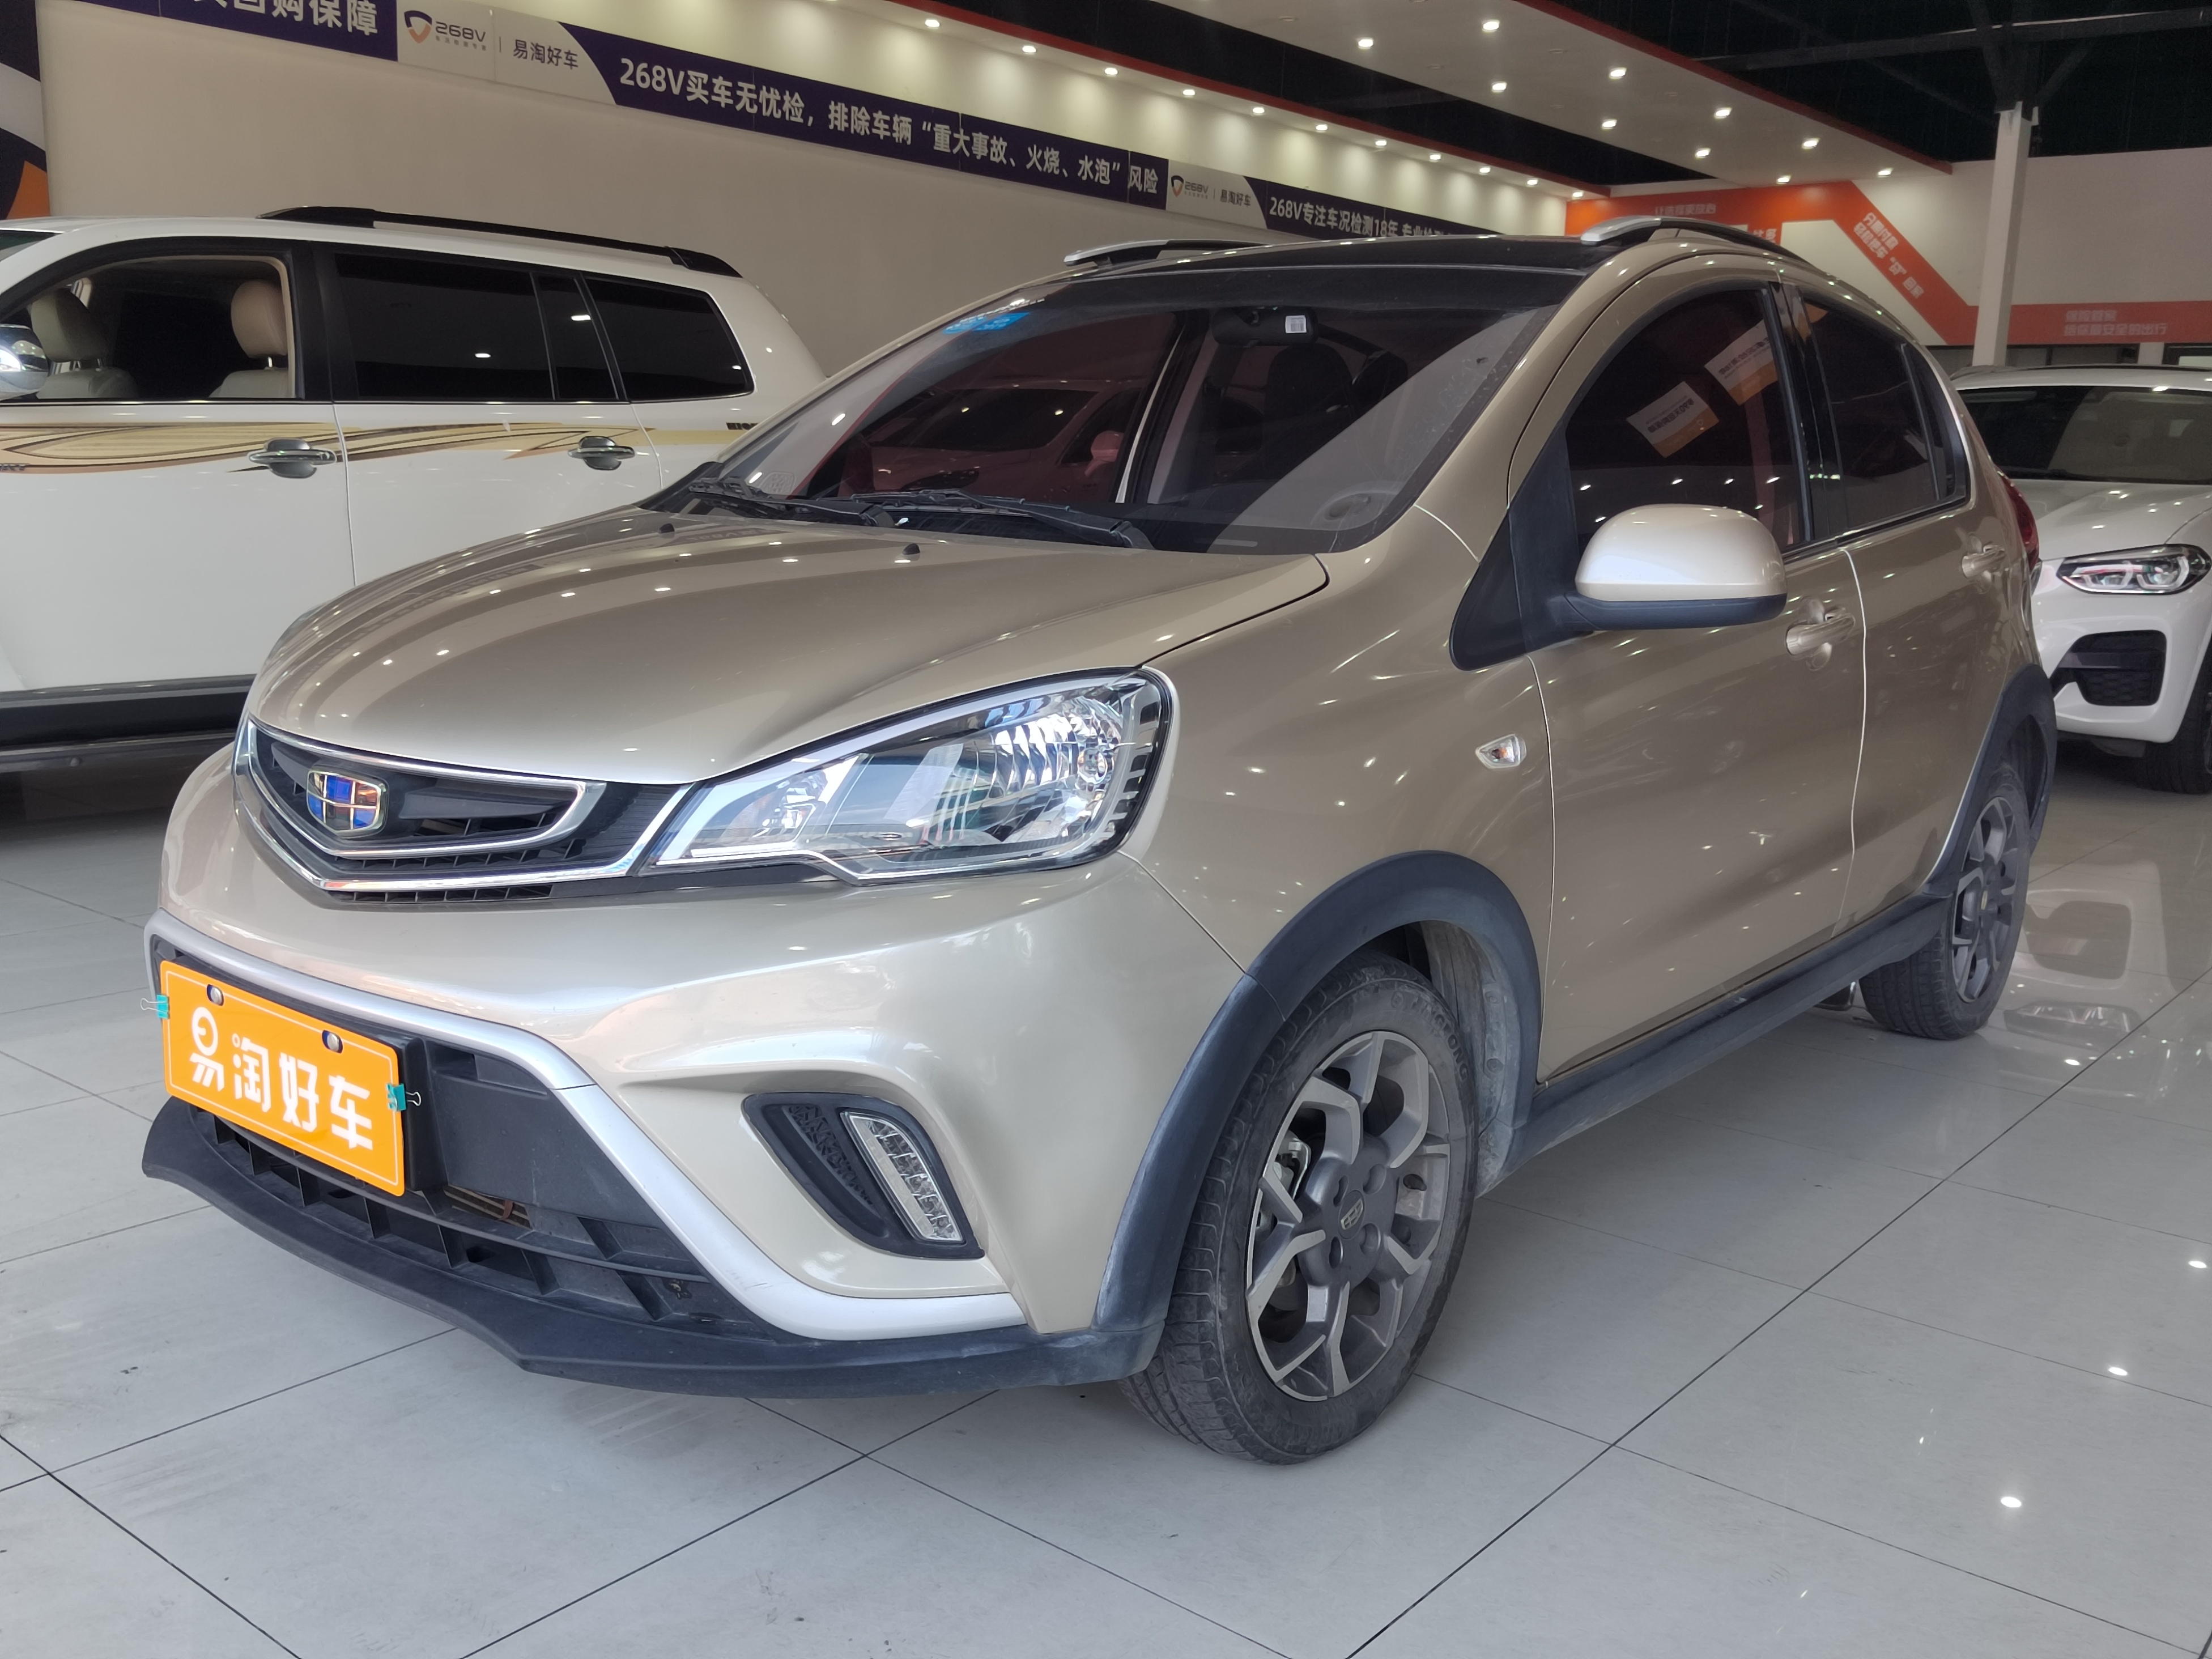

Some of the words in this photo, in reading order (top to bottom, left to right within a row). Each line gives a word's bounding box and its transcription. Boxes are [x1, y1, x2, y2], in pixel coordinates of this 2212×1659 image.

[435, 20, 486, 42] 268V
[513, 39, 578, 70] 易淘好车
[190, 1006, 373, 1150] 易淘好车
